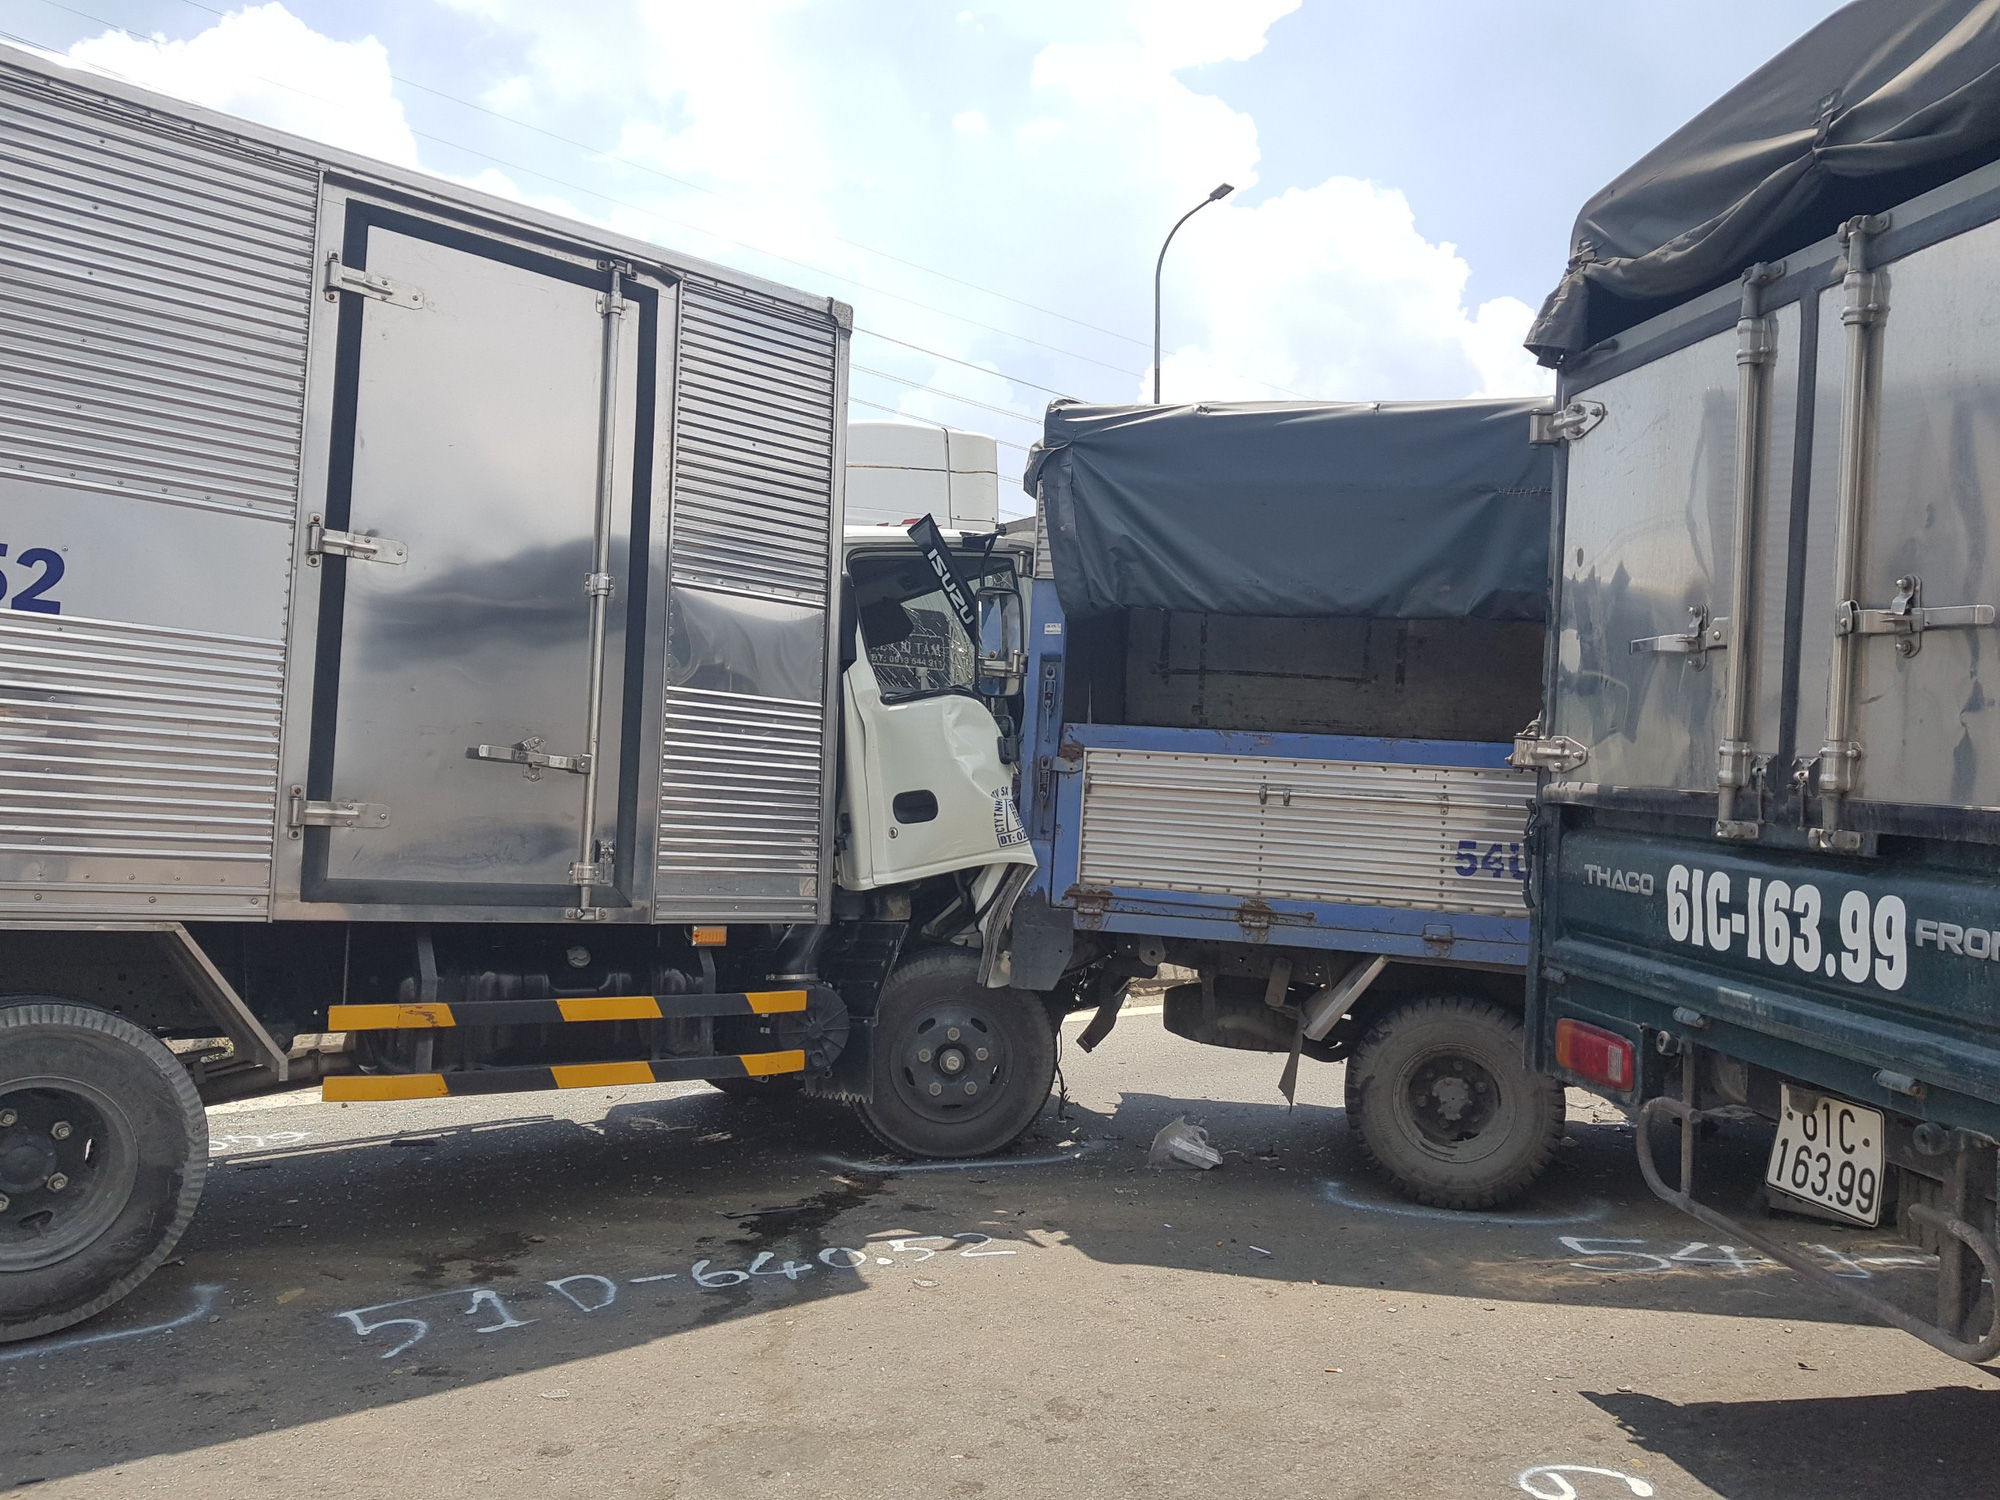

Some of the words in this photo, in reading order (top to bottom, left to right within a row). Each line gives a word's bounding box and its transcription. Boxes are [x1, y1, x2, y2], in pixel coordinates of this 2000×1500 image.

[0, 543, 65, 615] 2
[927, 549, 974, 625] ISUZU
[1583, 863, 1654, 896] THACO
[1666, 864, 1907, 991] 61C-163.99
[1776, 1137, 1876, 1215] 163.99
